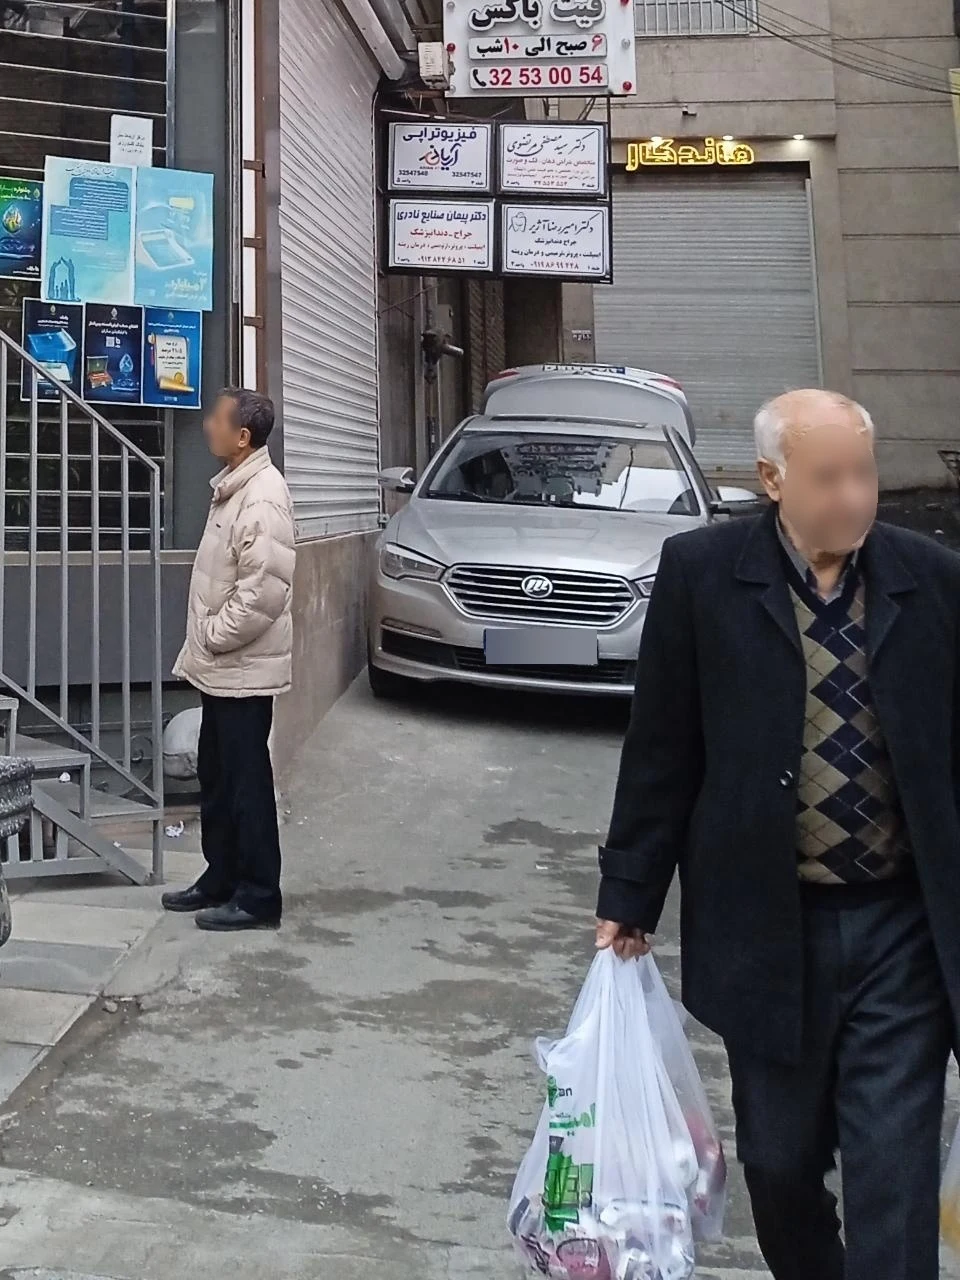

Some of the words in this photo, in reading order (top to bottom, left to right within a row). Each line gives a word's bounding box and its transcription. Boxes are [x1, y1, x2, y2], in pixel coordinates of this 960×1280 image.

[476, 38, 503, 57] شب
[525, 37, 551, 56] الی
[556, 38, 587, 55] صبح
[489, 68, 512, 86] 32
[519, 67, 542, 85] 53
[548, 66, 572, 84] 00
[579, 65, 603, 84] 54
[402, 126, 477, 143] فیزیوتراپی
[397, 209, 420, 221] نادری
[447, 211, 469, 224] پیمان
[470, 211, 487, 222] دکتر
